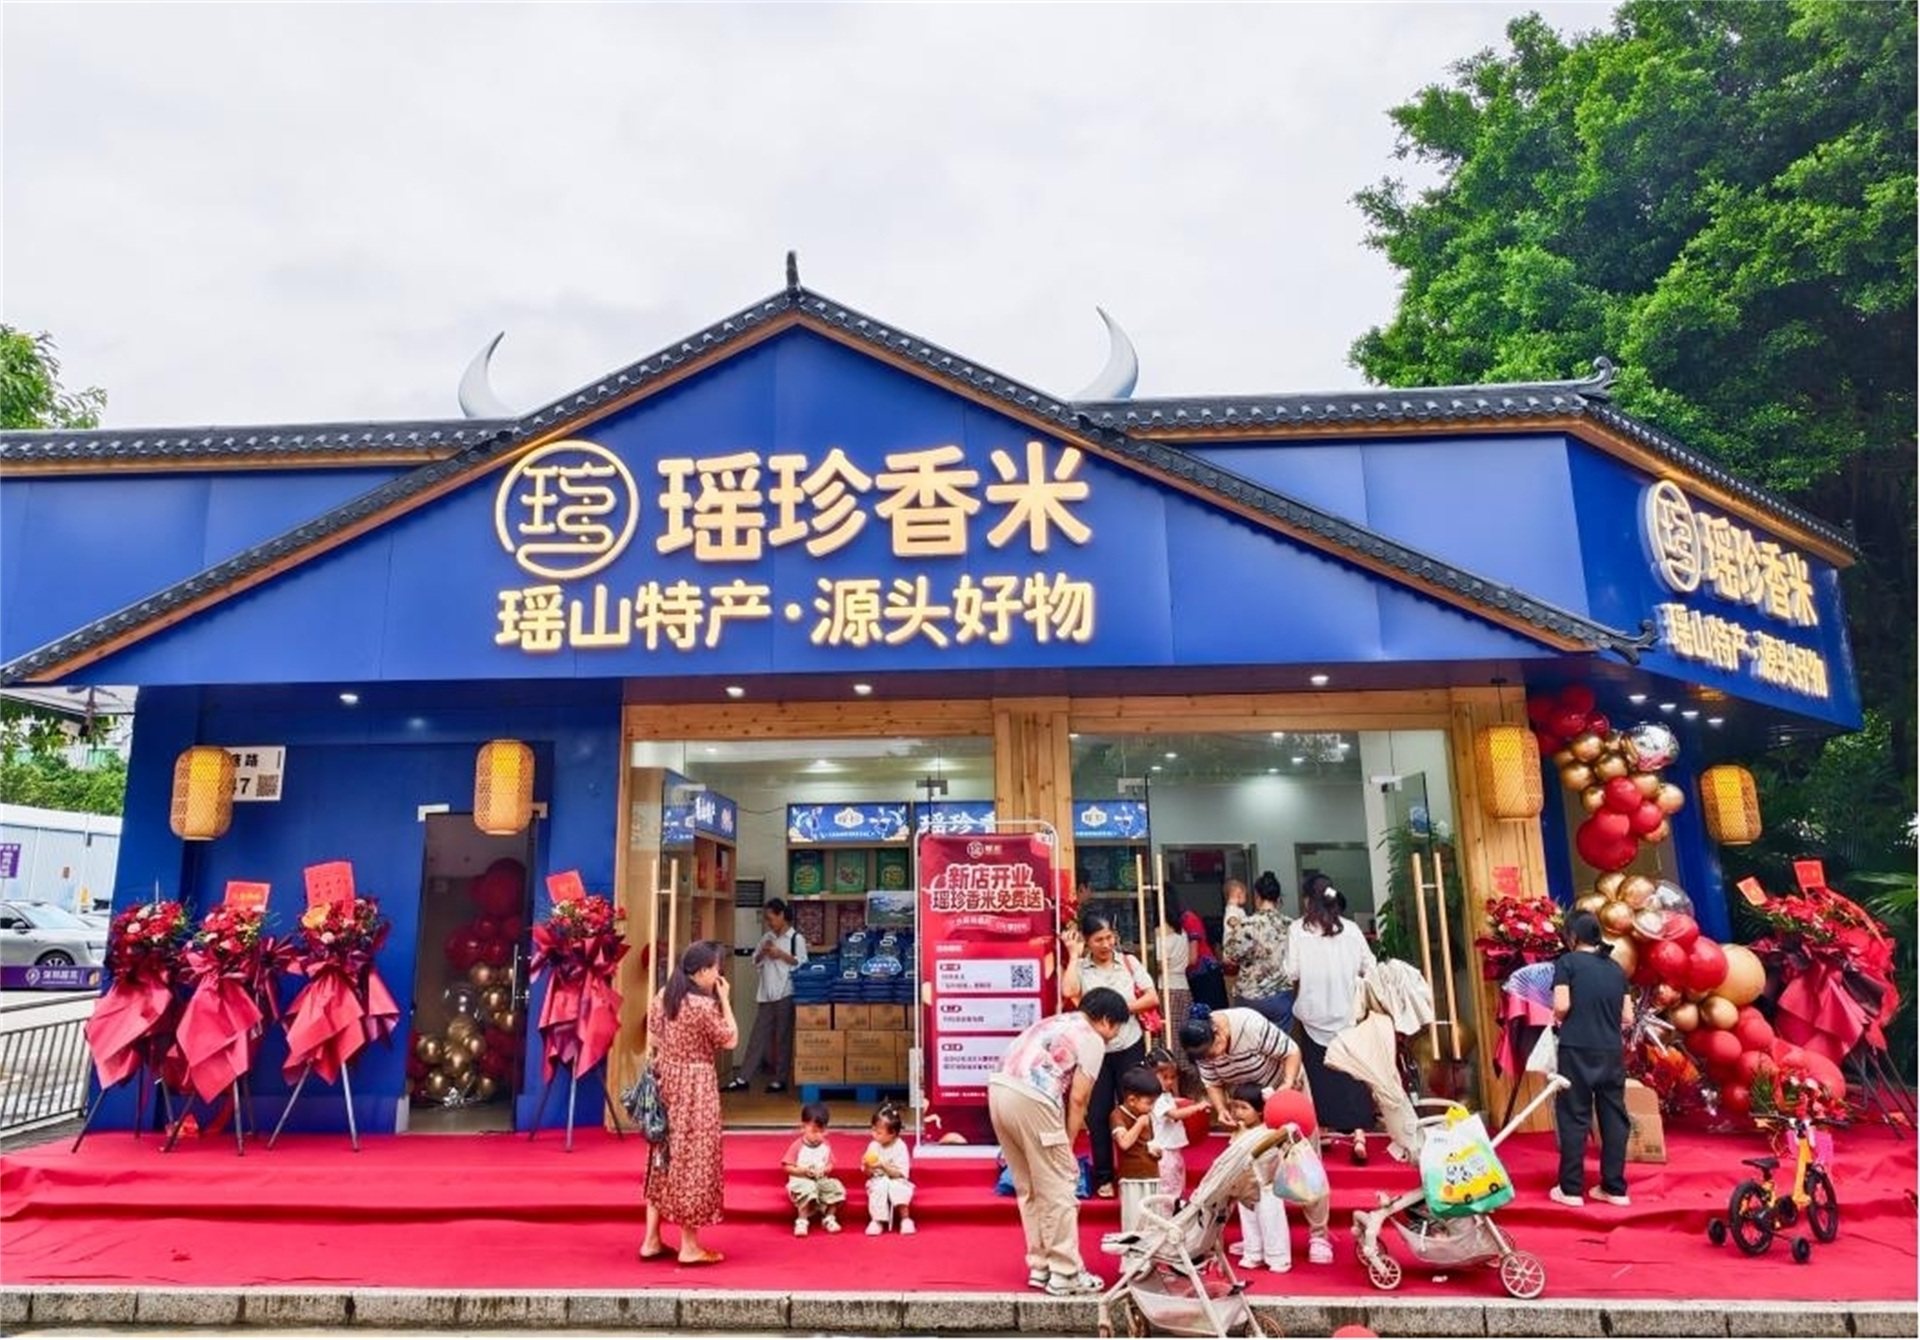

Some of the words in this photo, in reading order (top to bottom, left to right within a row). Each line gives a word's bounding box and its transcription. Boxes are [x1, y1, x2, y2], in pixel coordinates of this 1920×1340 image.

[657, 441, 1092, 562] 瑶珍香米
[1697, 511, 1819, 627] 瑶珍香米
[495, 572, 1094, 652] 瑶山特产·源头好物
[931, 889, 1043, 911] 瑶珍香米免费送
[946, 864, 1032, 890] 新店开业
